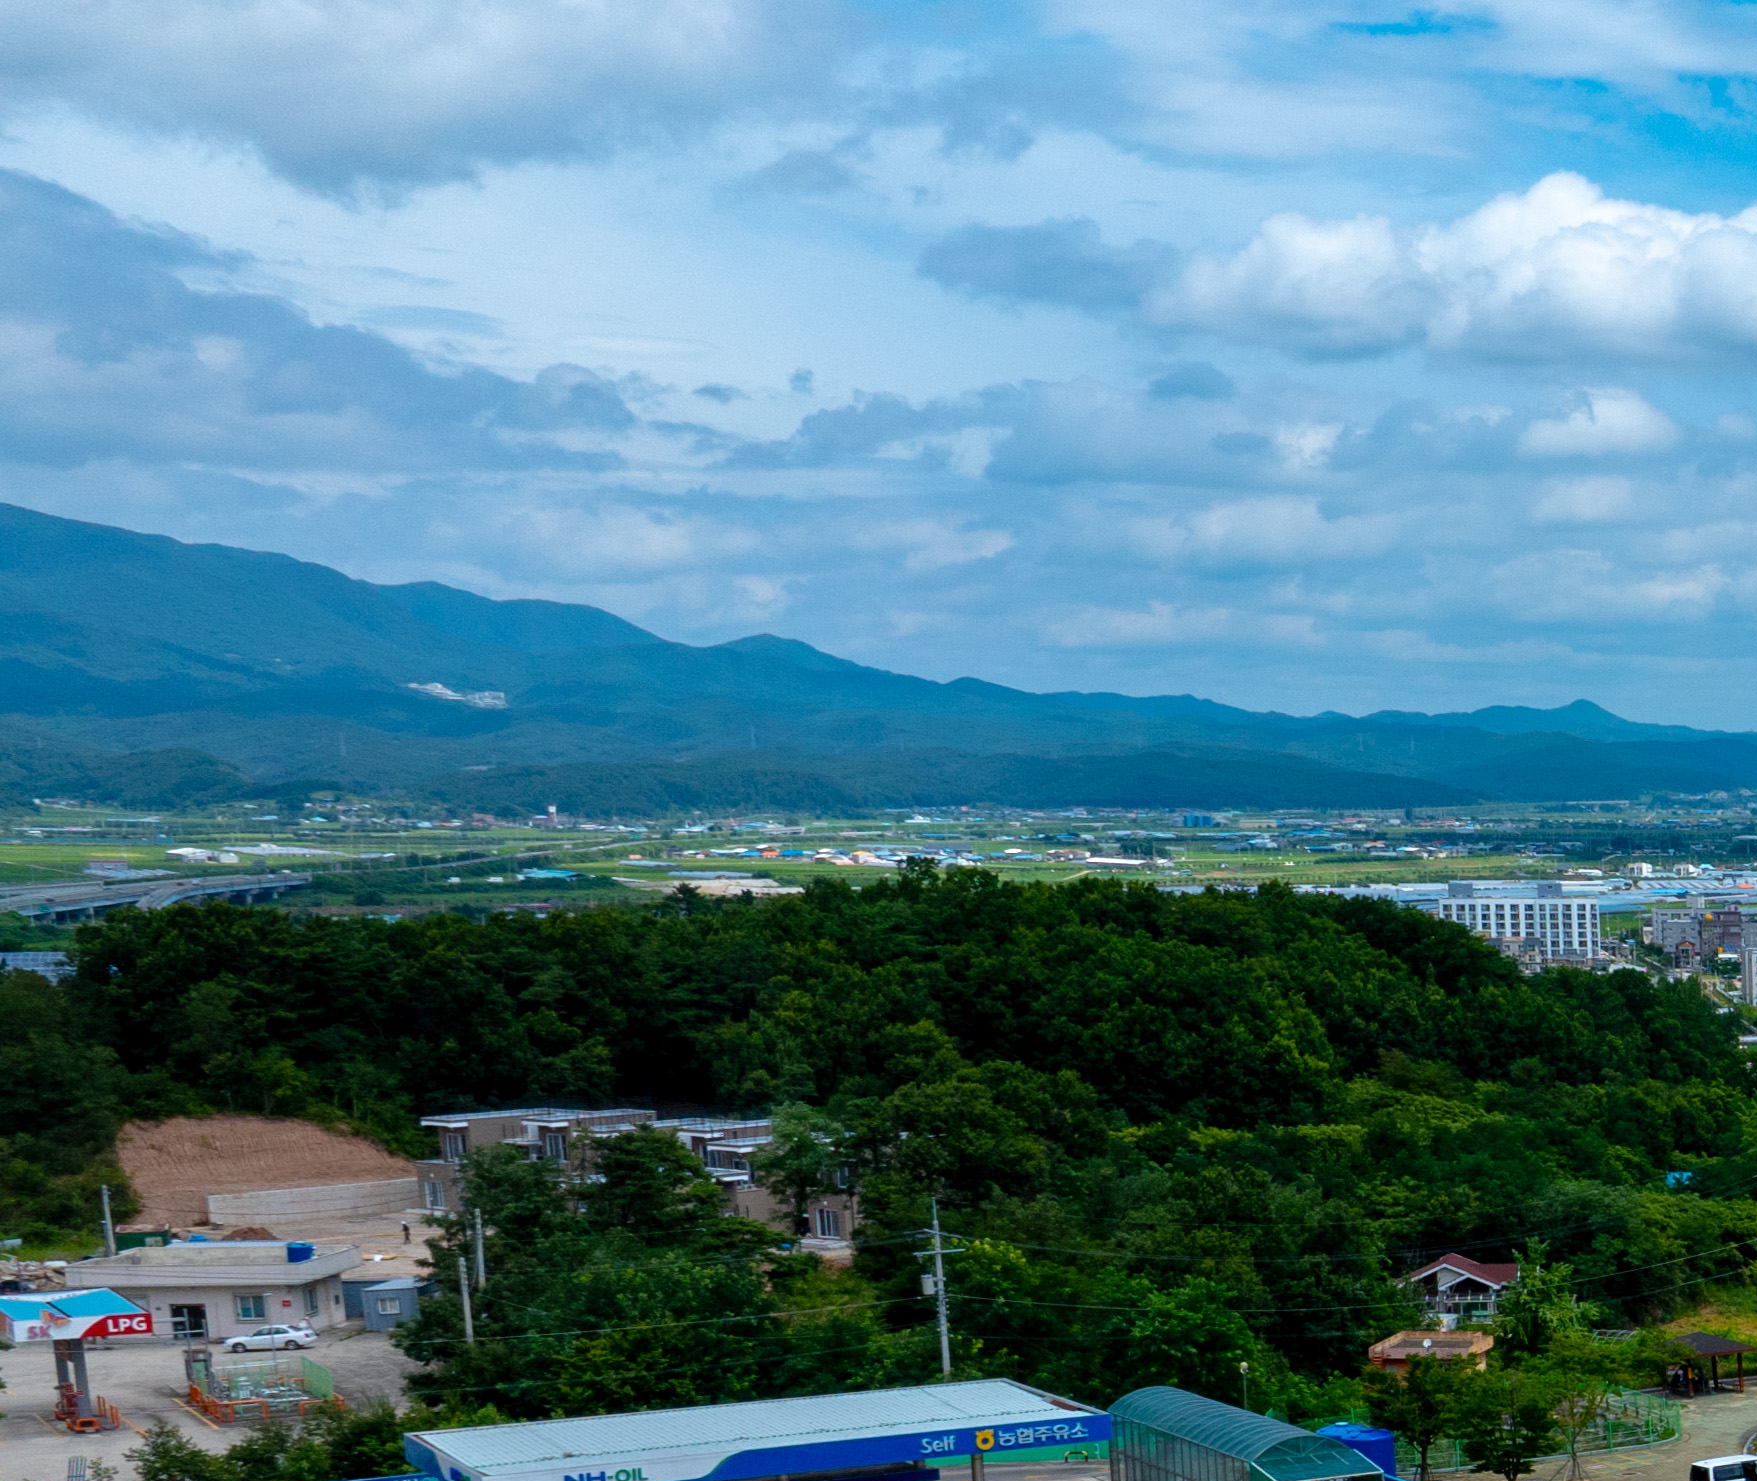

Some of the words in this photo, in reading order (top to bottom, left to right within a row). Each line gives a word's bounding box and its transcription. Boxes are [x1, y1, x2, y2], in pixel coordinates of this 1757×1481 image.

[26, 1324, 51, 1340] SK
[107, 1316, 148, 1333] LPG
[921, 1435, 957, 1454] Self
[998, 1421, 1089, 1447] 농협주유소
